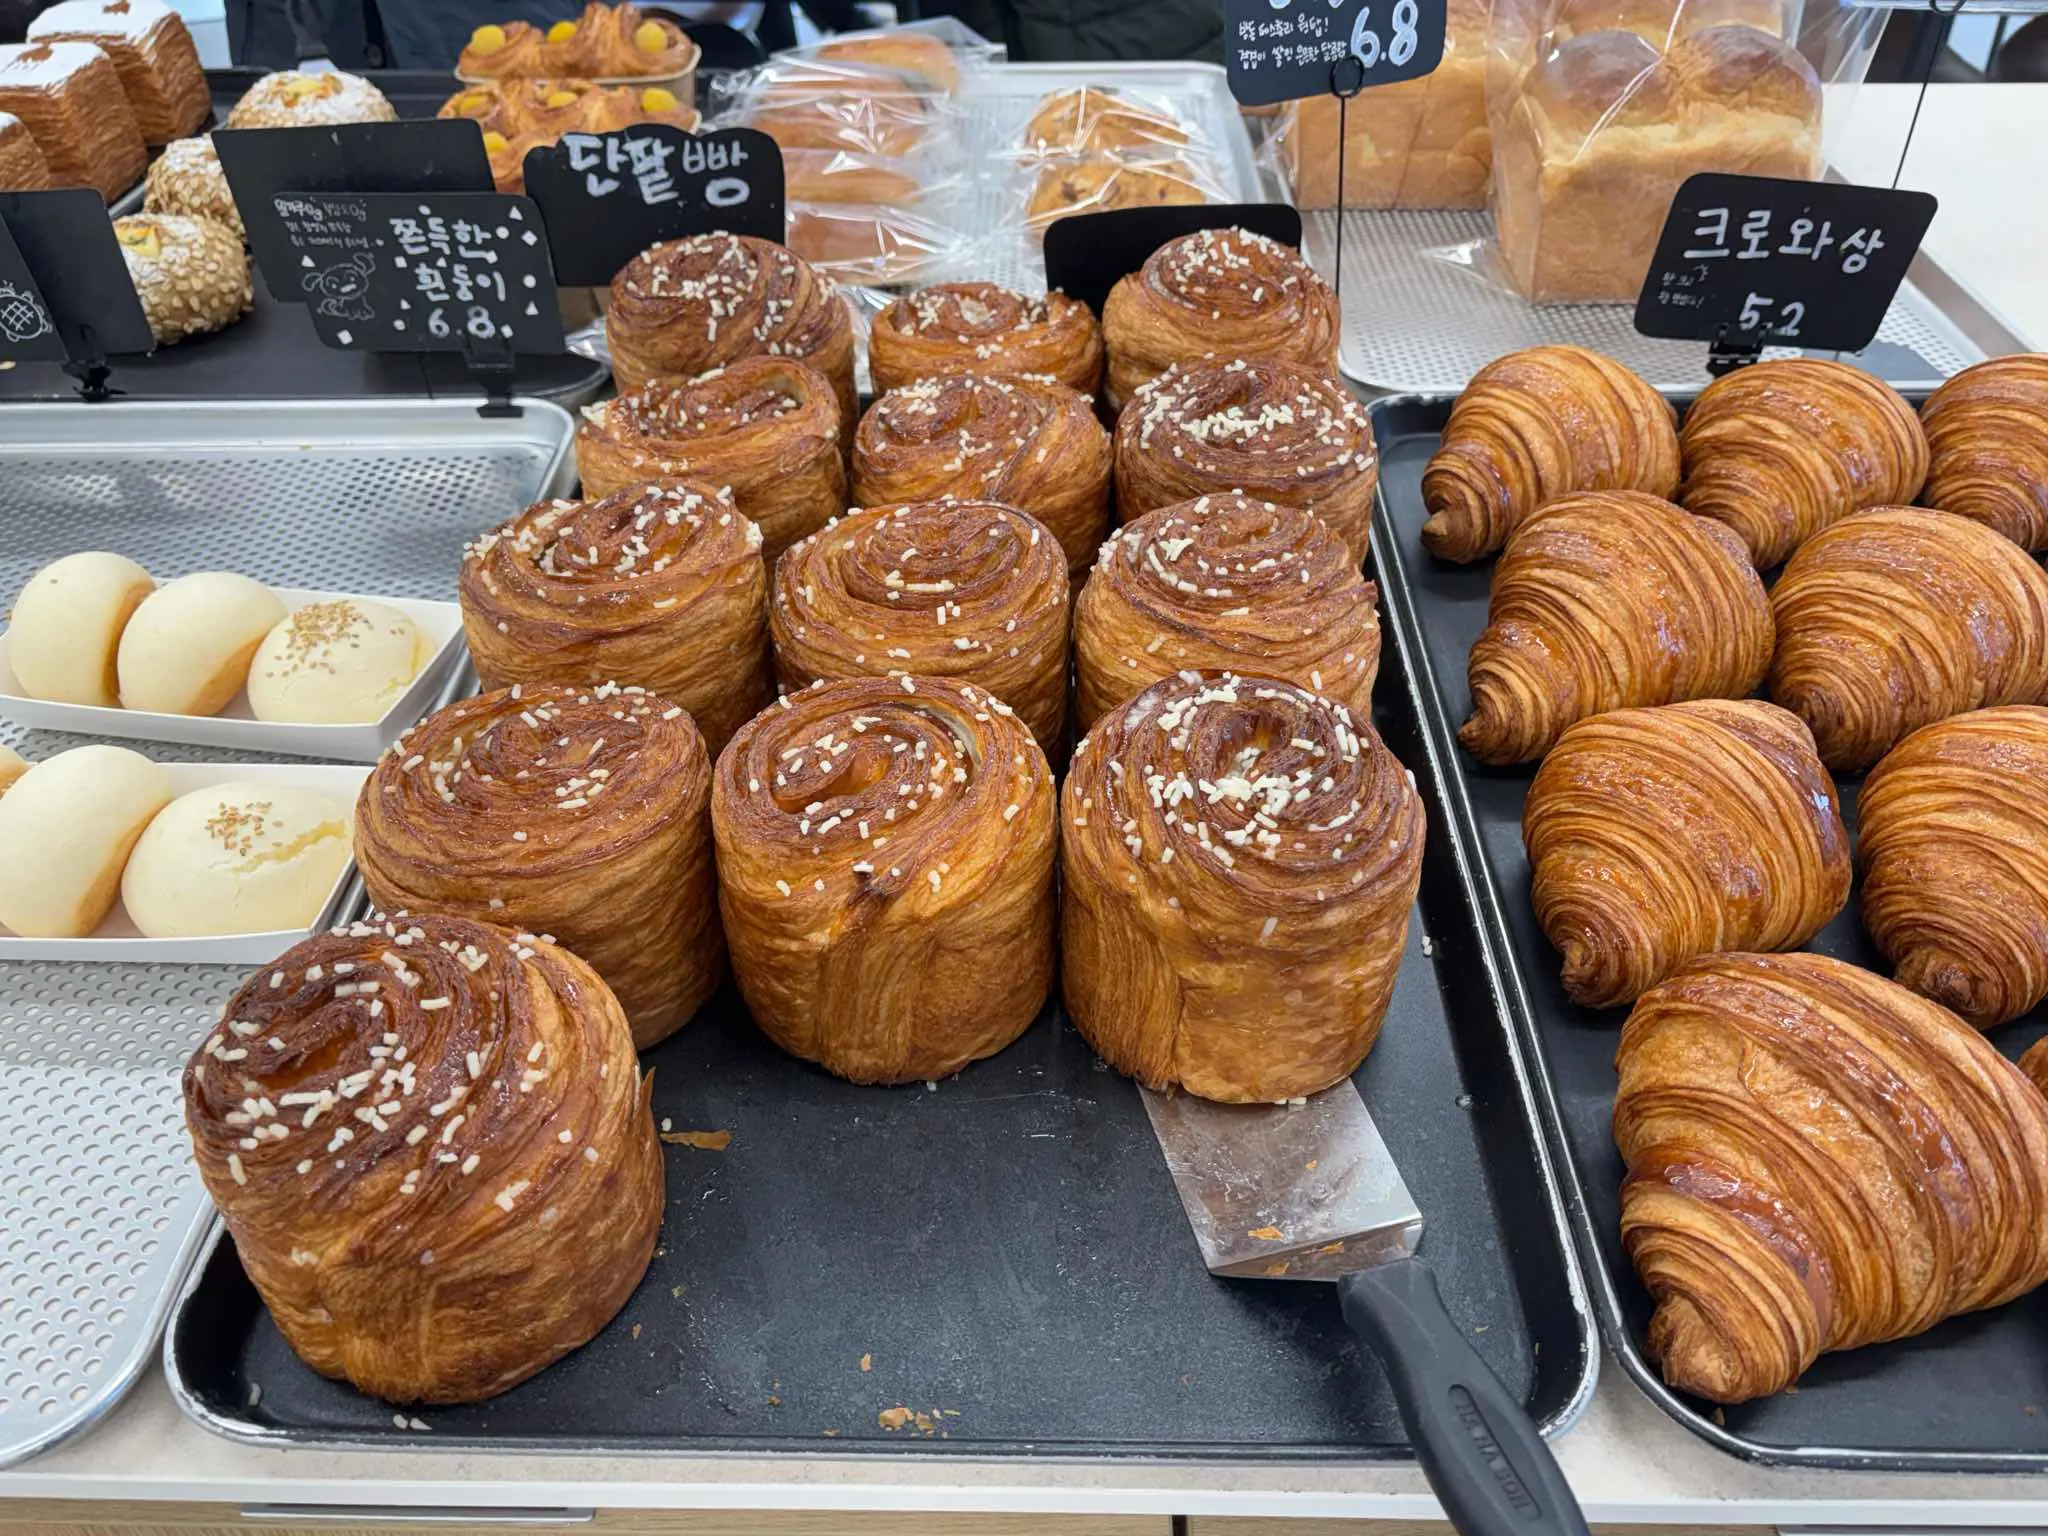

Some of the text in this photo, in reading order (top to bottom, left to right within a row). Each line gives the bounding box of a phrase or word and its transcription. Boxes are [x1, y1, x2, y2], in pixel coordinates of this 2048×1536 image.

[1350, 0, 1419, 68] 6.8
[562, 134, 749, 207] 단팥빵
[389, 217, 492, 259] 쫀득한
[1683, 207, 1886, 275] 크로와상
[414, 262, 506, 302] 흰둥이
[427, 305, 496, 339] 6.8
[1738, 292, 1805, 337] 5.2
